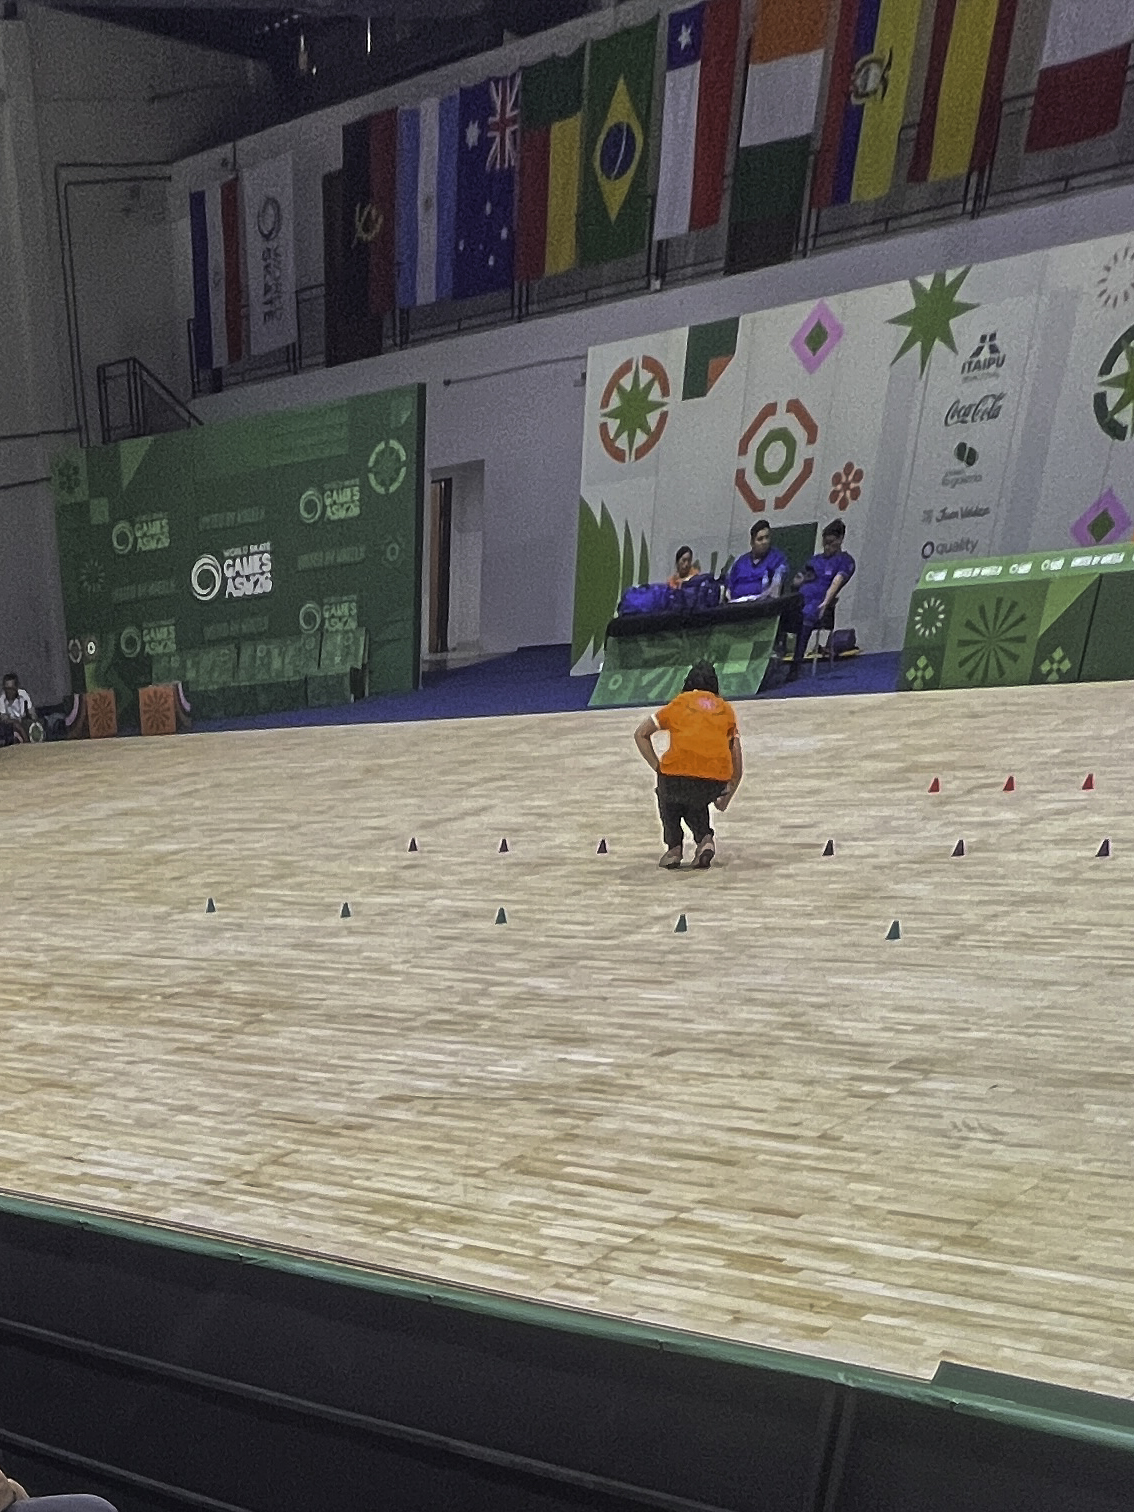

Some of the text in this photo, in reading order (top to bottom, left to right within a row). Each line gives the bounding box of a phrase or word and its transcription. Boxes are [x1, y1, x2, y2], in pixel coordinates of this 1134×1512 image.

[961, 354, 1006, 375] ITAIPU
[936, 537, 979, 555] quality
[223, 552, 272, 578] GAMES
